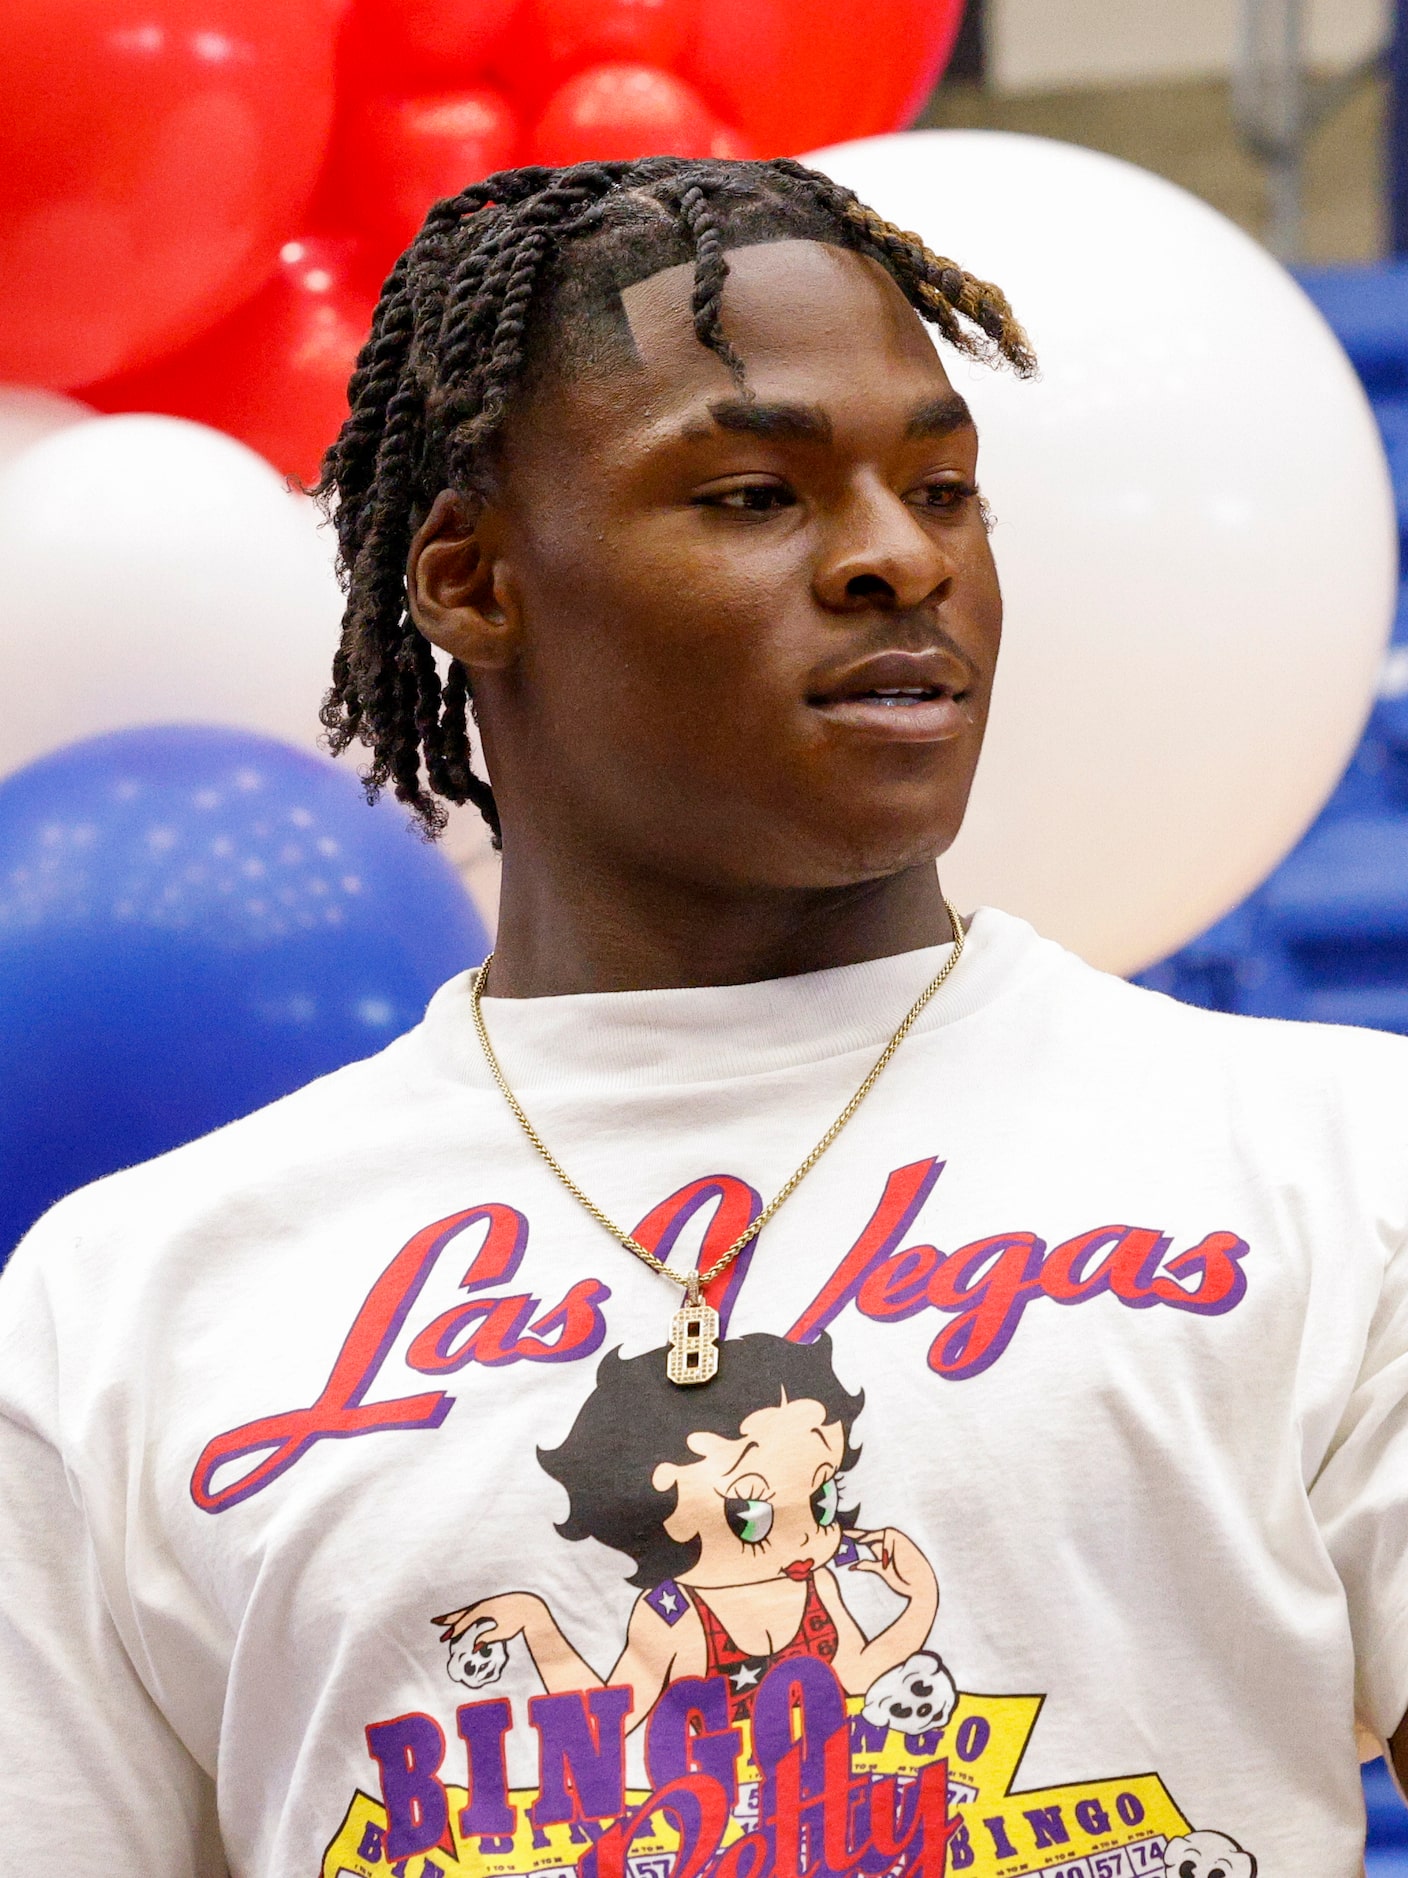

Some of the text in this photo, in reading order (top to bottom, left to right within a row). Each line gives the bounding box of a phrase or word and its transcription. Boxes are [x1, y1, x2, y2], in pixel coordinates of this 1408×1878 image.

[190, 1155, 1251, 1515] Las Vegas
[667, 1306, 719, 1384] 8
[365, 1654, 848, 1864] BINGO
[950, 1792, 1145, 1870] BINGO
[1095, 1853, 1122, 1878] 57
[1132, 1842, 1164, 1867] 74
